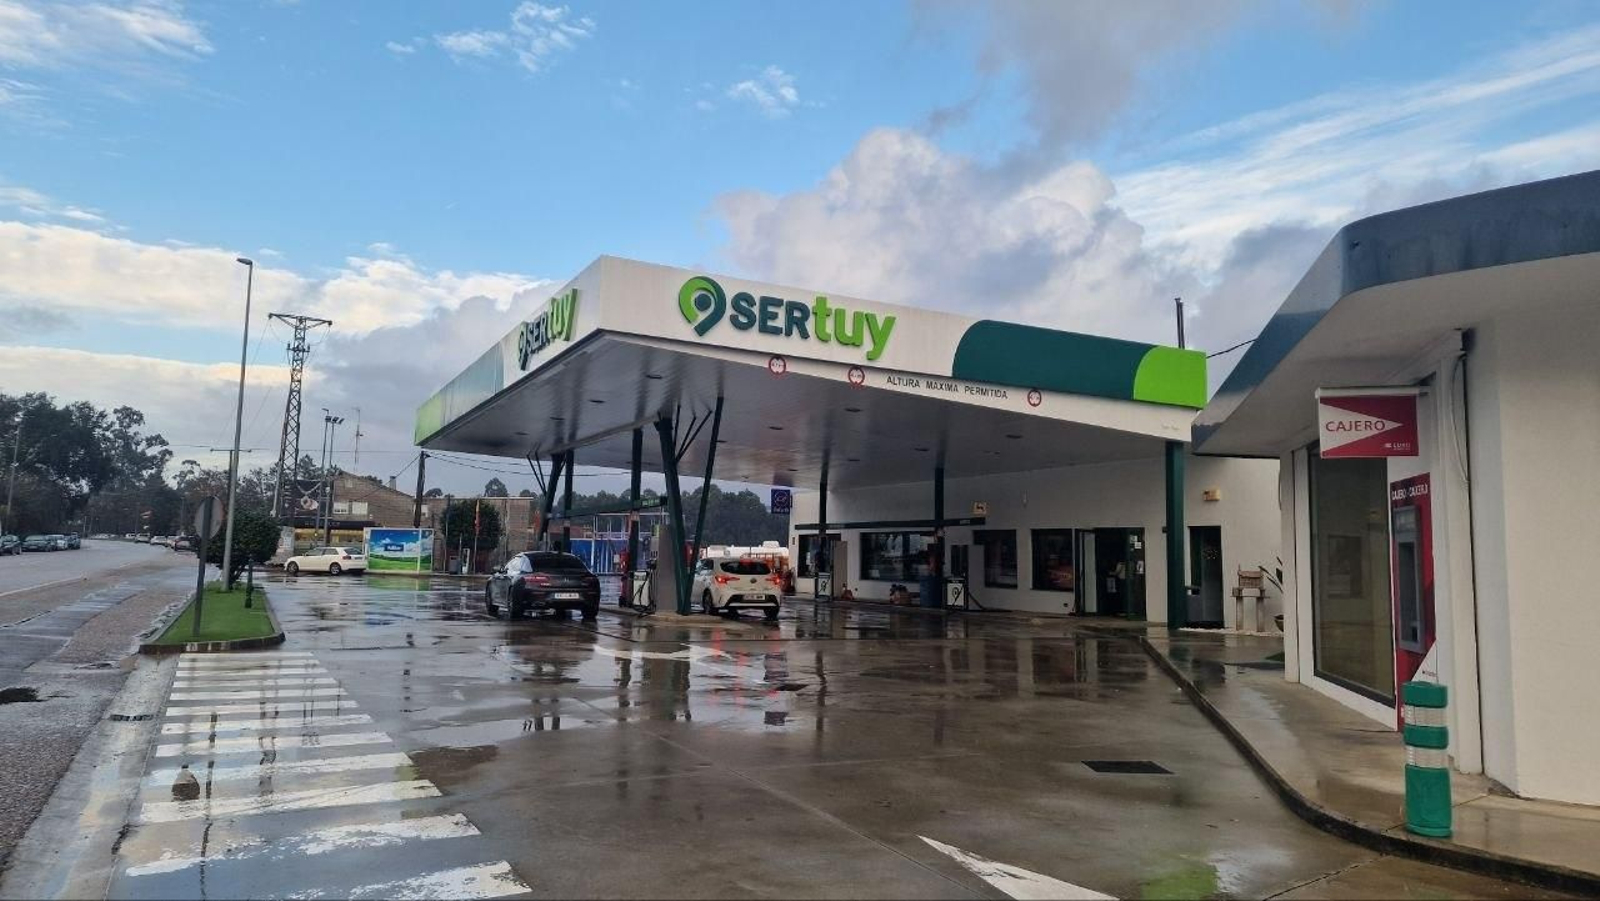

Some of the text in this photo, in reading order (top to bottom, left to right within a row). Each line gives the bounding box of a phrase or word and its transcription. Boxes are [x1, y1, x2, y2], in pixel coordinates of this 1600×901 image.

[527, 288, 578, 354] SERtuy
[730, 292, 896, 360] SERtuy
[886, 375, 1008, 399] ALTURA MAXIMA PERMITIDA
[1325, 420, 1386, 432] CAJERO
